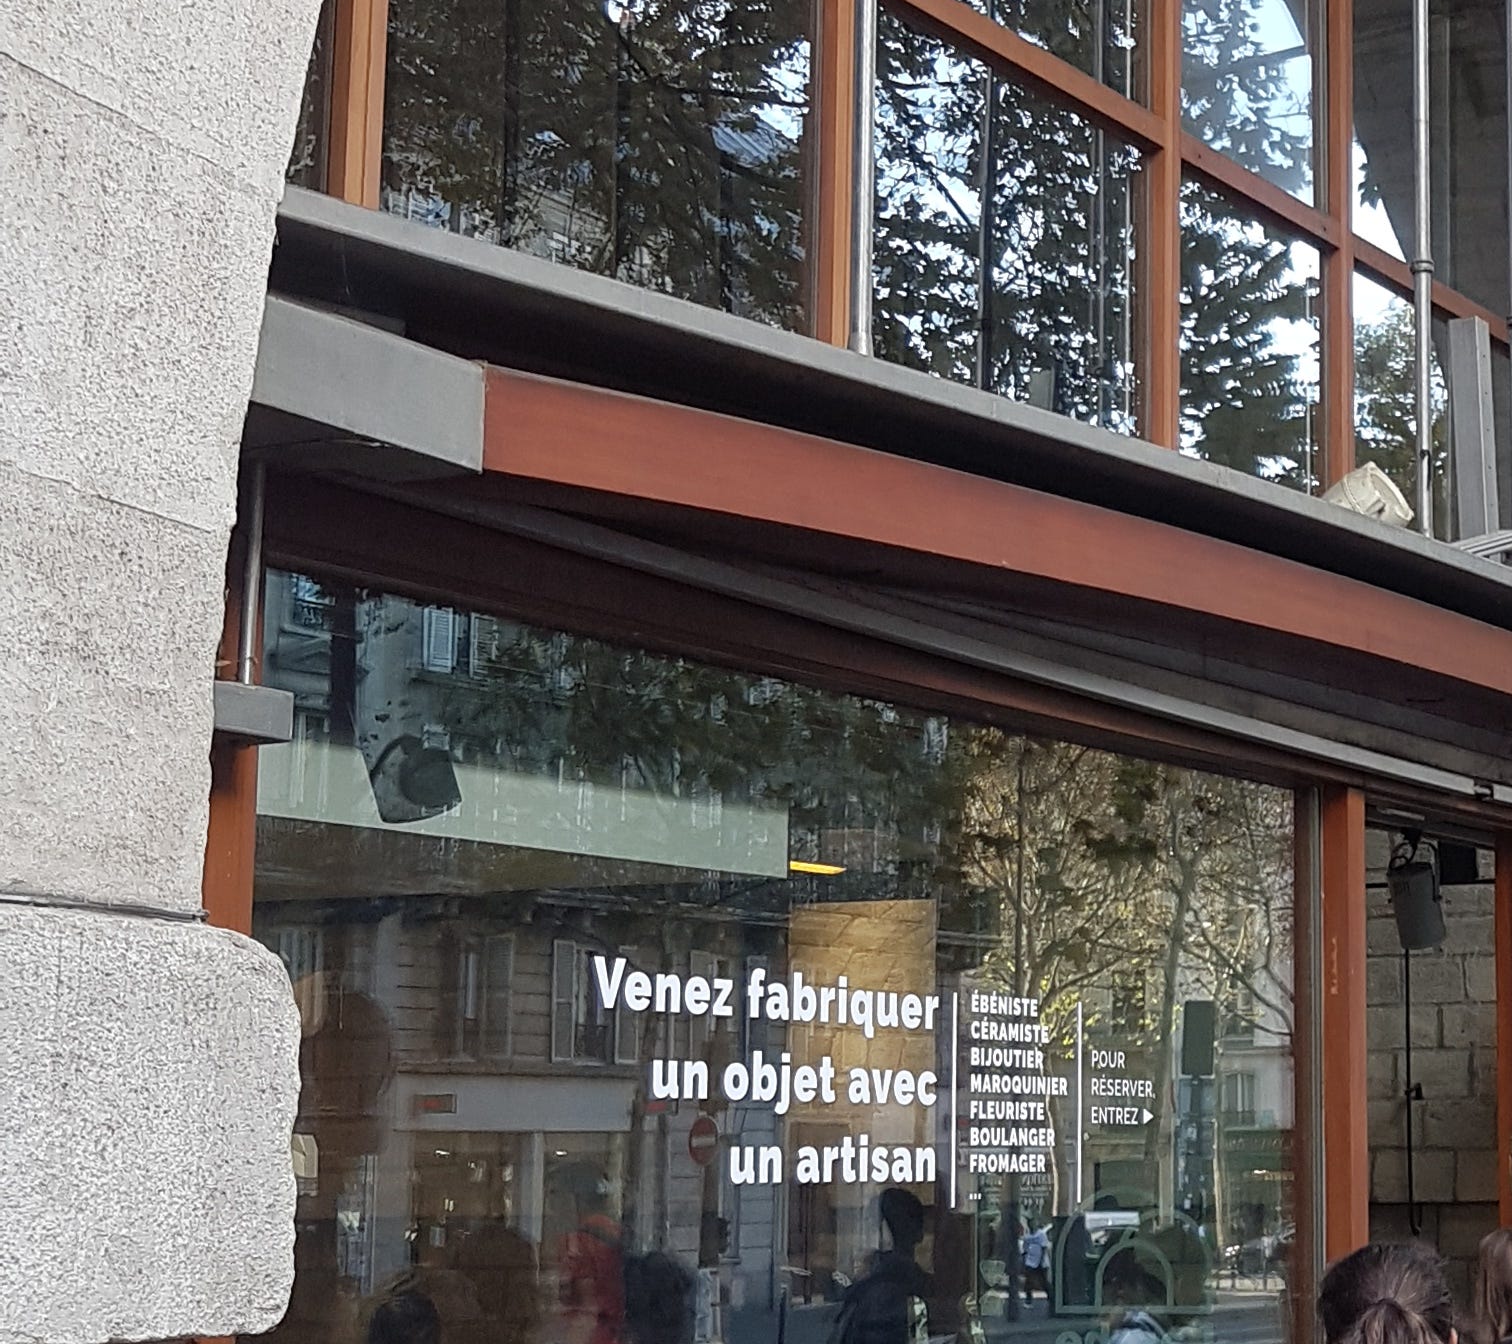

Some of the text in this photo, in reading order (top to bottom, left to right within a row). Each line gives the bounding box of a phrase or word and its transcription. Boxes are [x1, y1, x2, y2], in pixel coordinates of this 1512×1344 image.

[594, 955, 940, 1039] Venez fabriquer
[970, 990, 1038, 1017] ÉBÉNISTE
[970, 1017, 1050, 1044] CÉRAMISTE
[970, 1047, 1044, 1070] BIJOUTIER
[1091, 1049, 1126, 1069] POUR
[652, 1050, 937, 1115] un objet avec
[970, 1073, 1068, 1096] MAROQUINIER
[970, 1100, 1045, 1121] FLEURISTE
[1091, 1106, 1139, 1125] ENTREZ
[970, 1126, 1055, 1147] BOULANGER
[730, 1135, 937, 1185] un artisan
[969, 1153, 1047, 1173] FROMAGER
